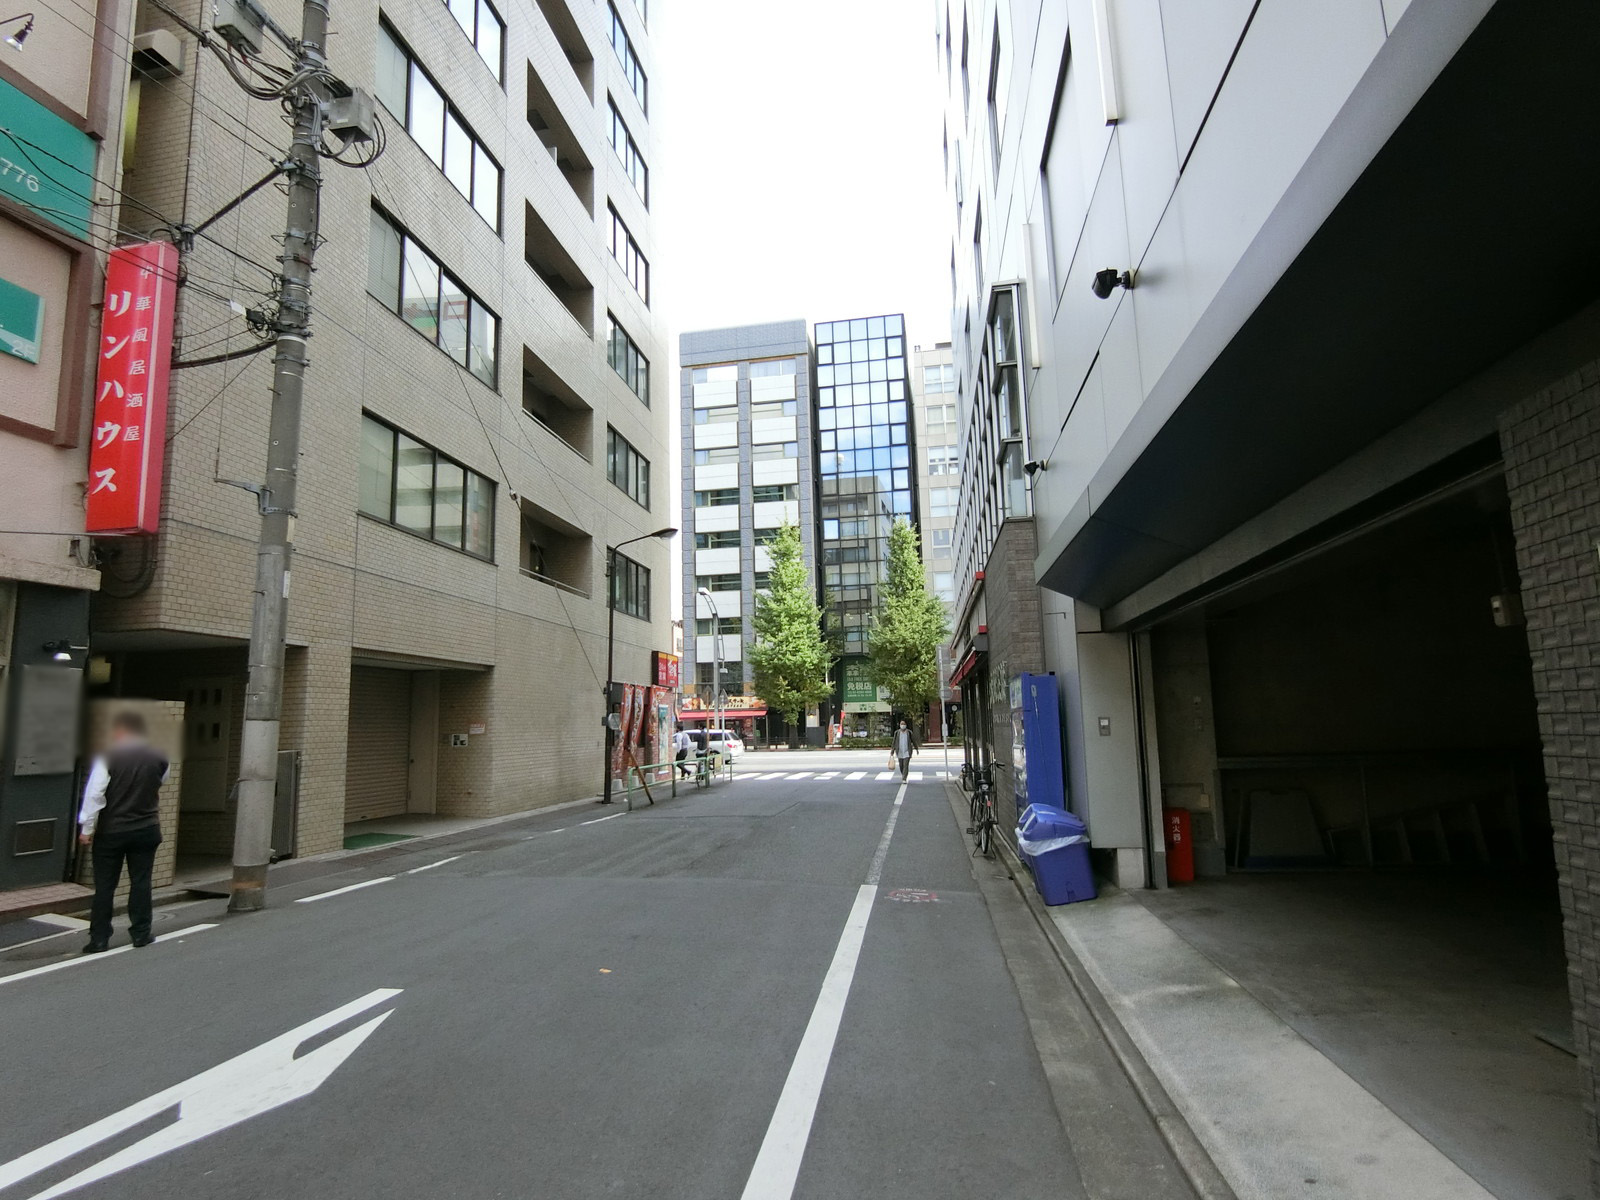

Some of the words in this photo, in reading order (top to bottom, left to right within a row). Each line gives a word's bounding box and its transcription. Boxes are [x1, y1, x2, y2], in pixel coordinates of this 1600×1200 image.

[92, 291, 132, 495] リンハウス
[123, 265, 154, 442] 中華風居酒屋
[847, 682, 872, 691] 免税店
